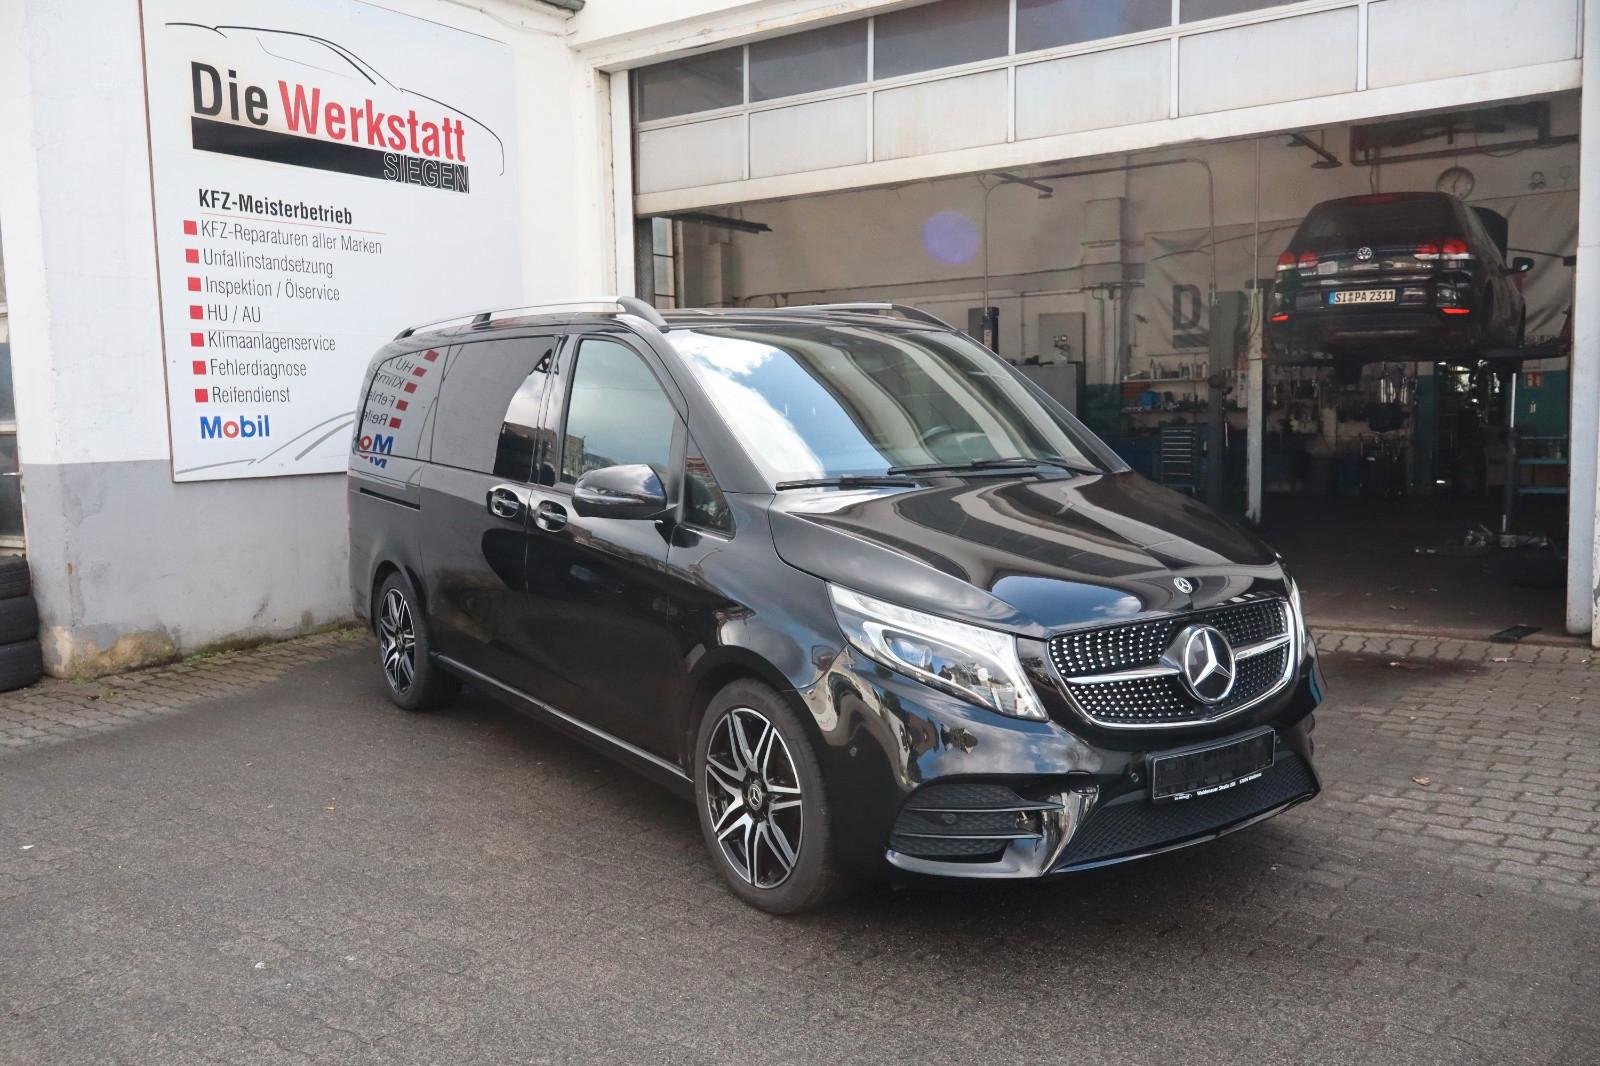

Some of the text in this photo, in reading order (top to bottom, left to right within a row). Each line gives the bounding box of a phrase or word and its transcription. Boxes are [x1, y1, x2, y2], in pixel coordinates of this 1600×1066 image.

[190, 60, 466, 162] Die Werkstatt
[383, 152, 470, 194] SIEGEN
[198, 188, 353, 225] KFZ-Meisterbetrieb
[200, 219, 382, 255] KFZ-Reparaturen aller Marken
[203, 249, 334, 279] Unfallinstandsetzung
[205, 276, 273, 298] Inspektion
[285, 278, 341, 301] Ölservice
[1369, 290, 1394, 301] 2311
[207, 303, 229, 322] HU
[242, 306, 261, 323] AU
[207, 330, 336, 353] Klimaanlagenservice
[210, 357, 307, 379] Fehlerdiagnose
[212, 386, 291, 403] Reifendienst
[200, 414, 271, 439] Mobil
